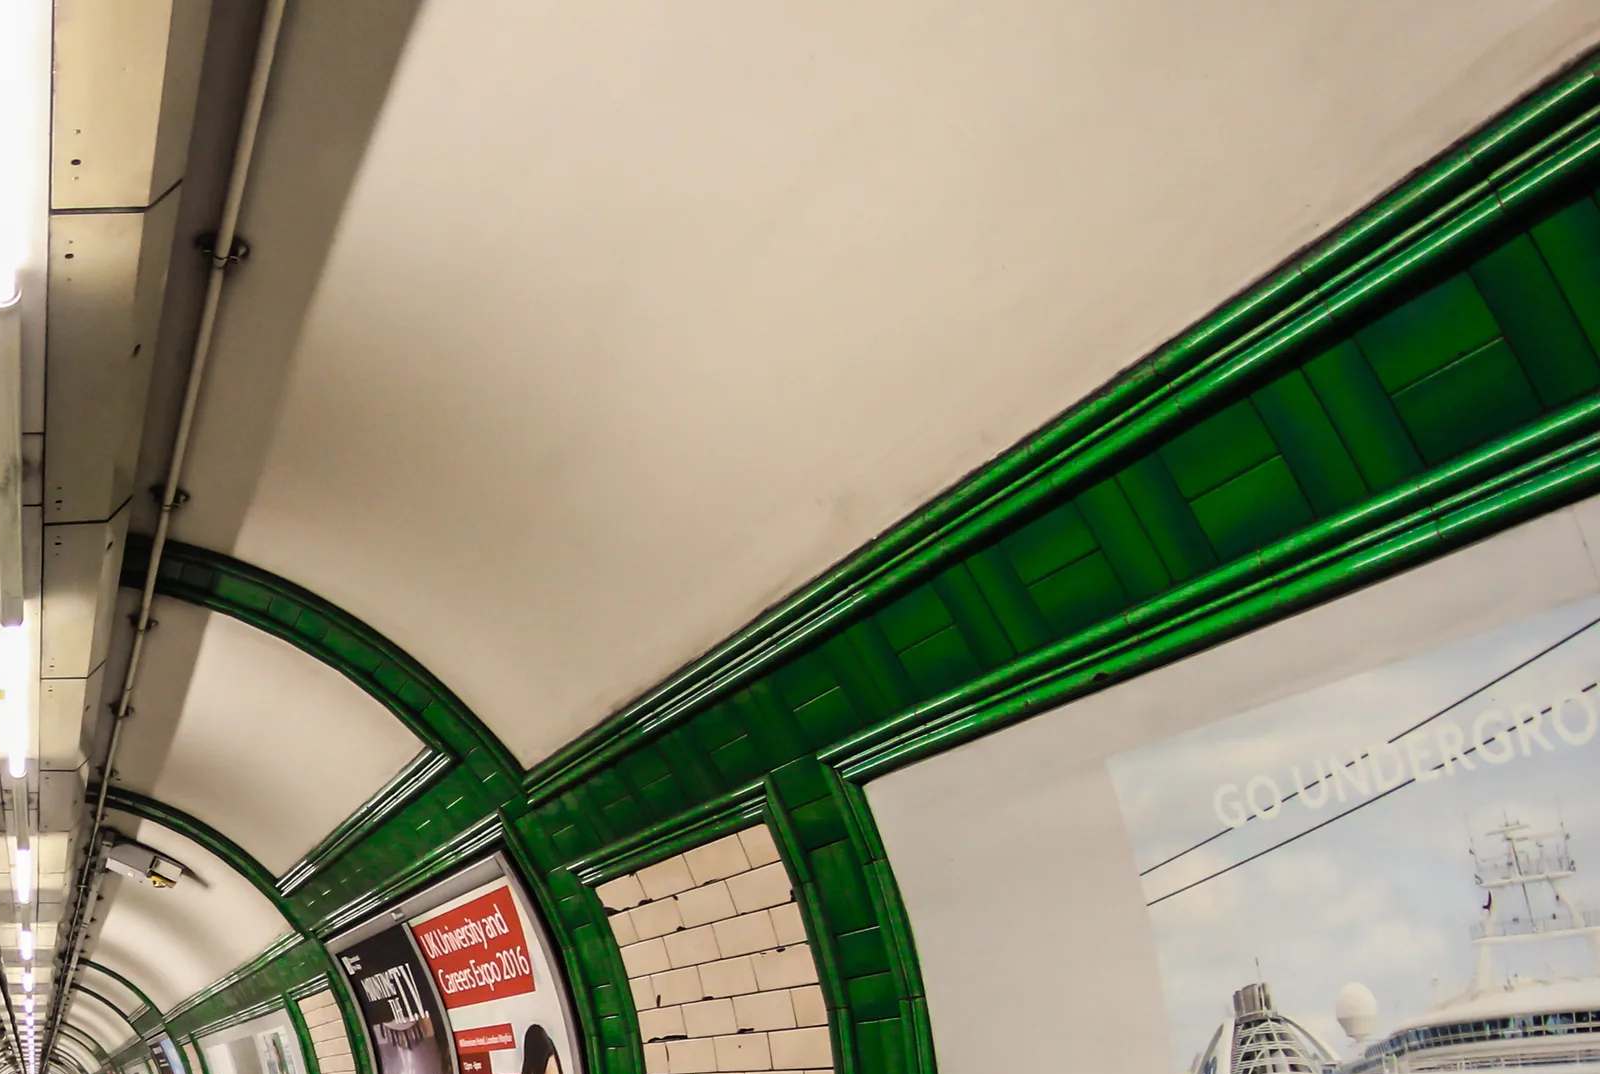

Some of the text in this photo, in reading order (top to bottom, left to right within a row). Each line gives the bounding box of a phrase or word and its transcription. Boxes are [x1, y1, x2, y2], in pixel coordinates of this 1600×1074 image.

[1213, 775, 1282, 828] GO
[420, 903, 509, 959] UK University and
[438, 945, 530, 994] Careers Expo 2016
